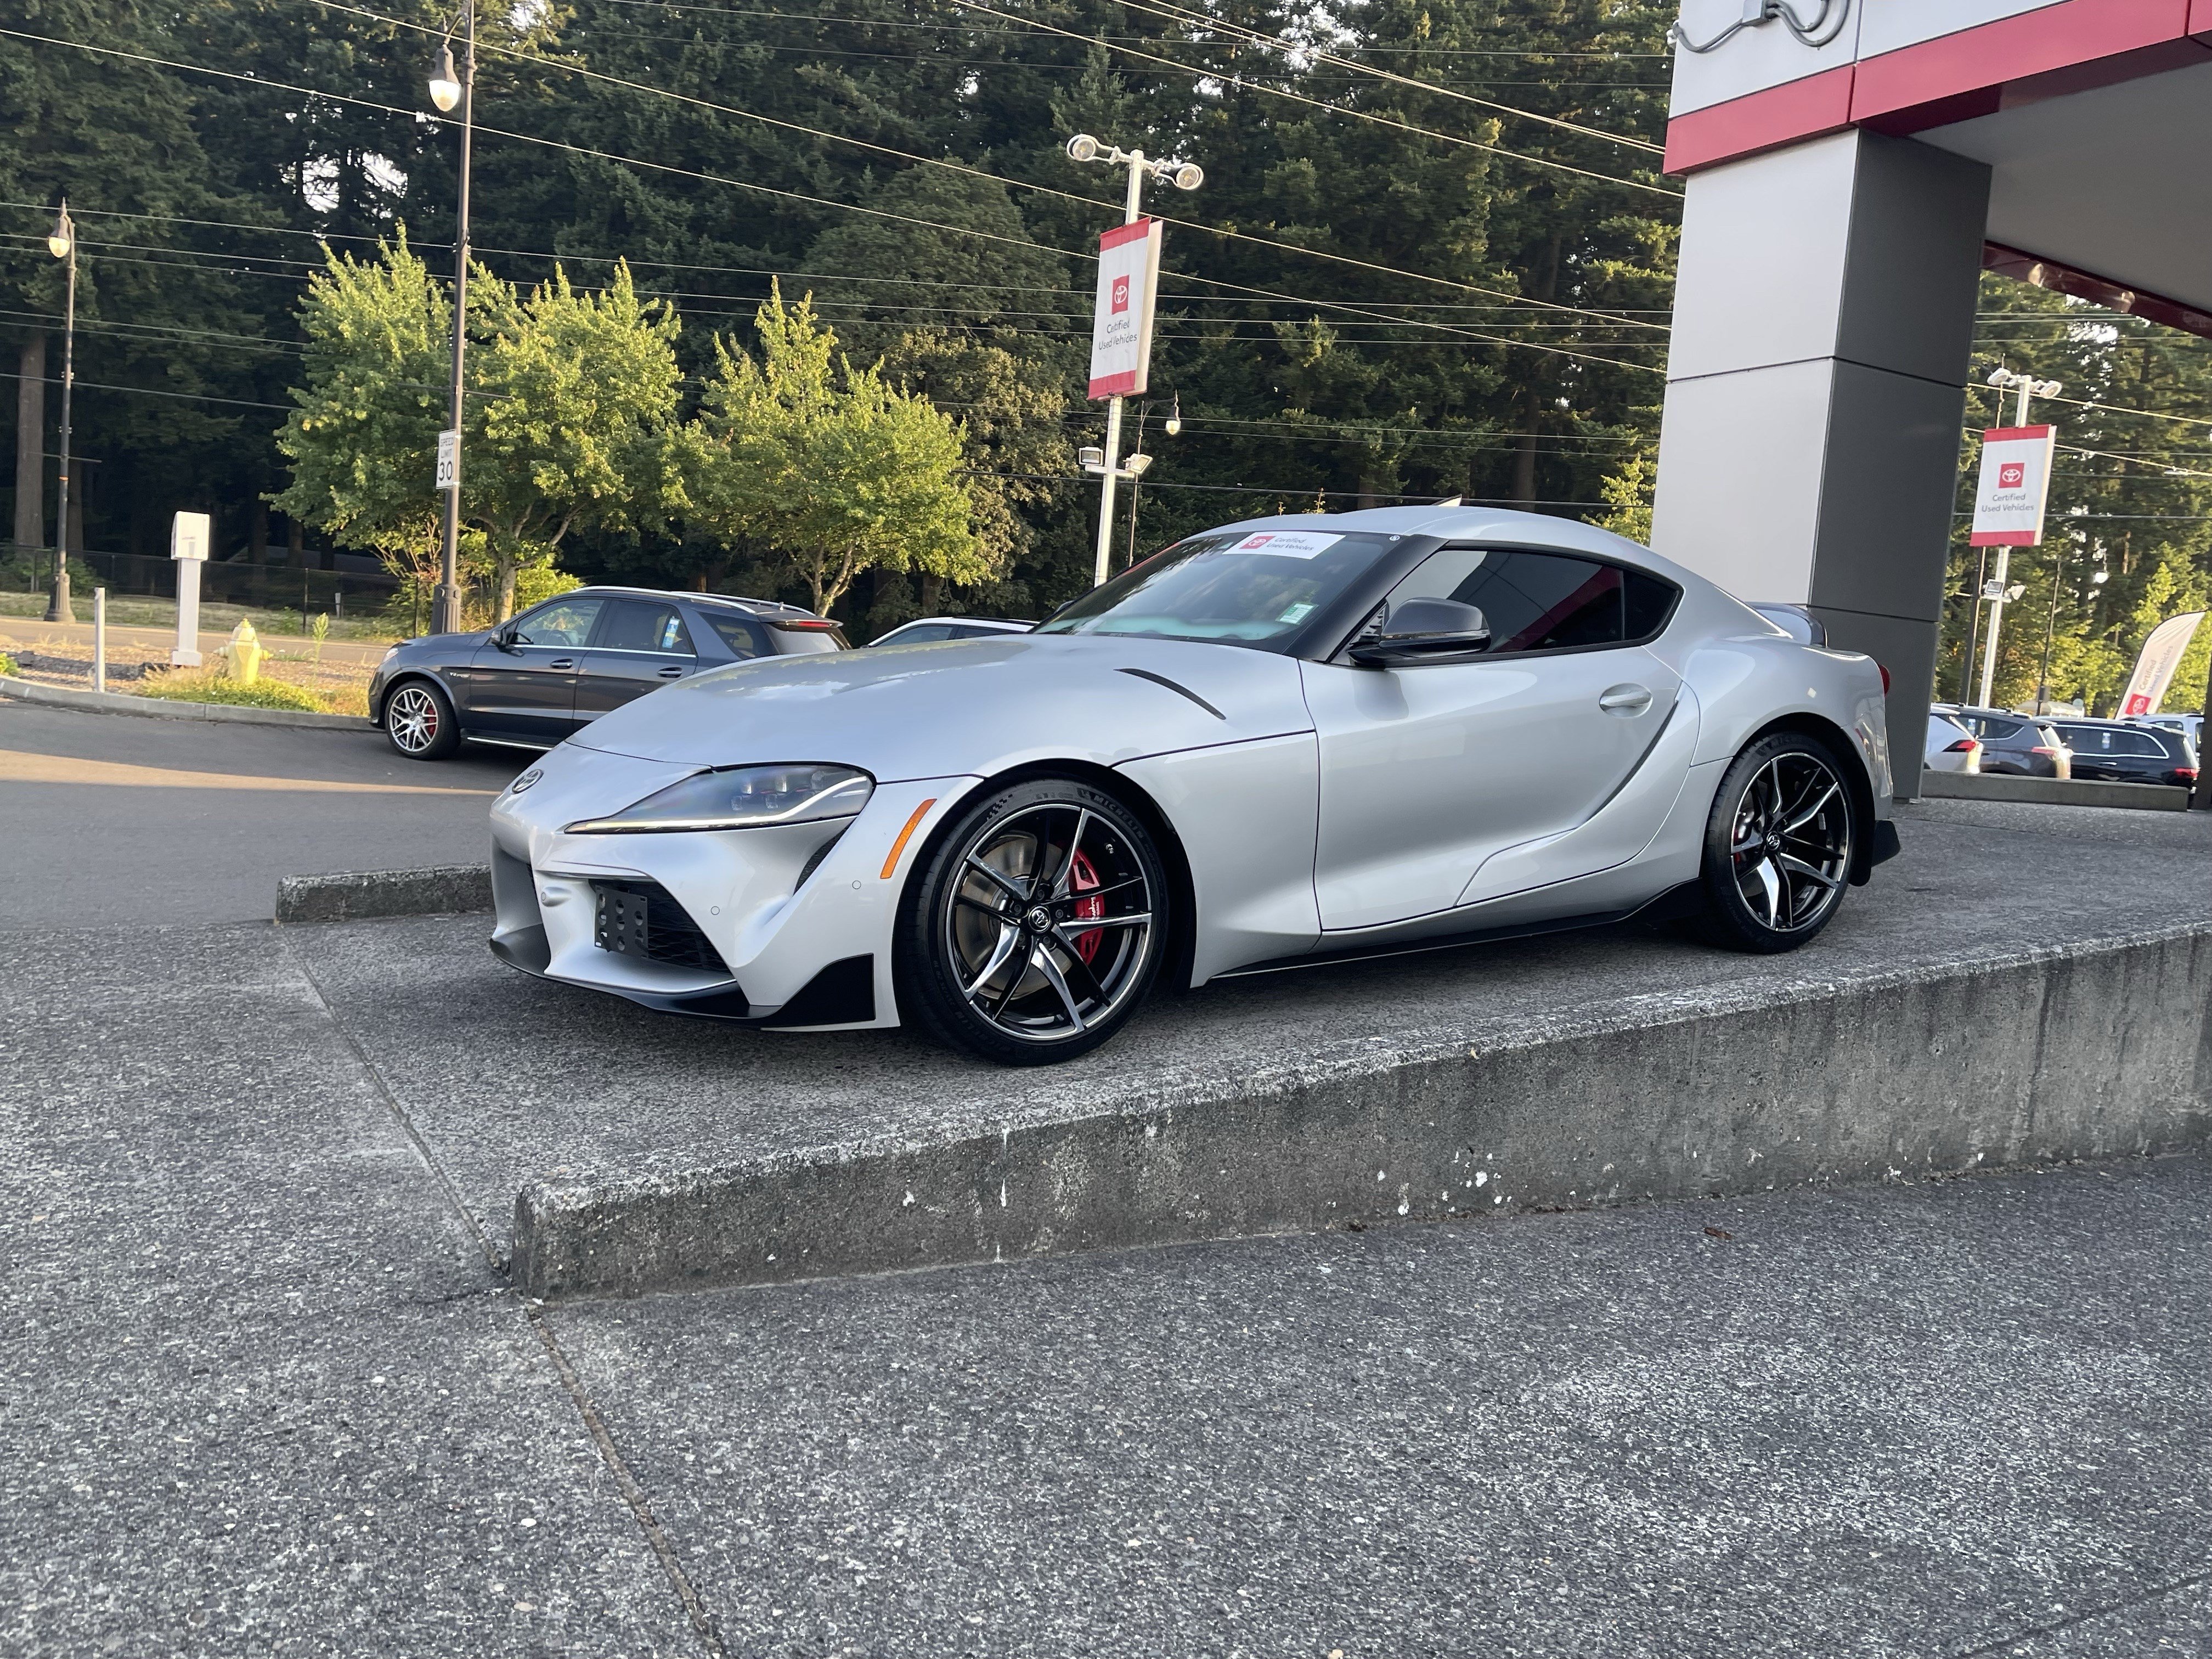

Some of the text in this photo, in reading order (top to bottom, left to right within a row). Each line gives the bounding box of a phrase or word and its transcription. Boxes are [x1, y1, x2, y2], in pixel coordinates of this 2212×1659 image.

[1107, 317, 1130, 334] Certified
[1098, 337, 1113, 350] Used
[438, 460, 453, 482] 30
[1992, 493, 2026, 502] Certified
[2139, 659, 2157, 690] Certified
[1093, 793, 1144, 839] MICHELIN
